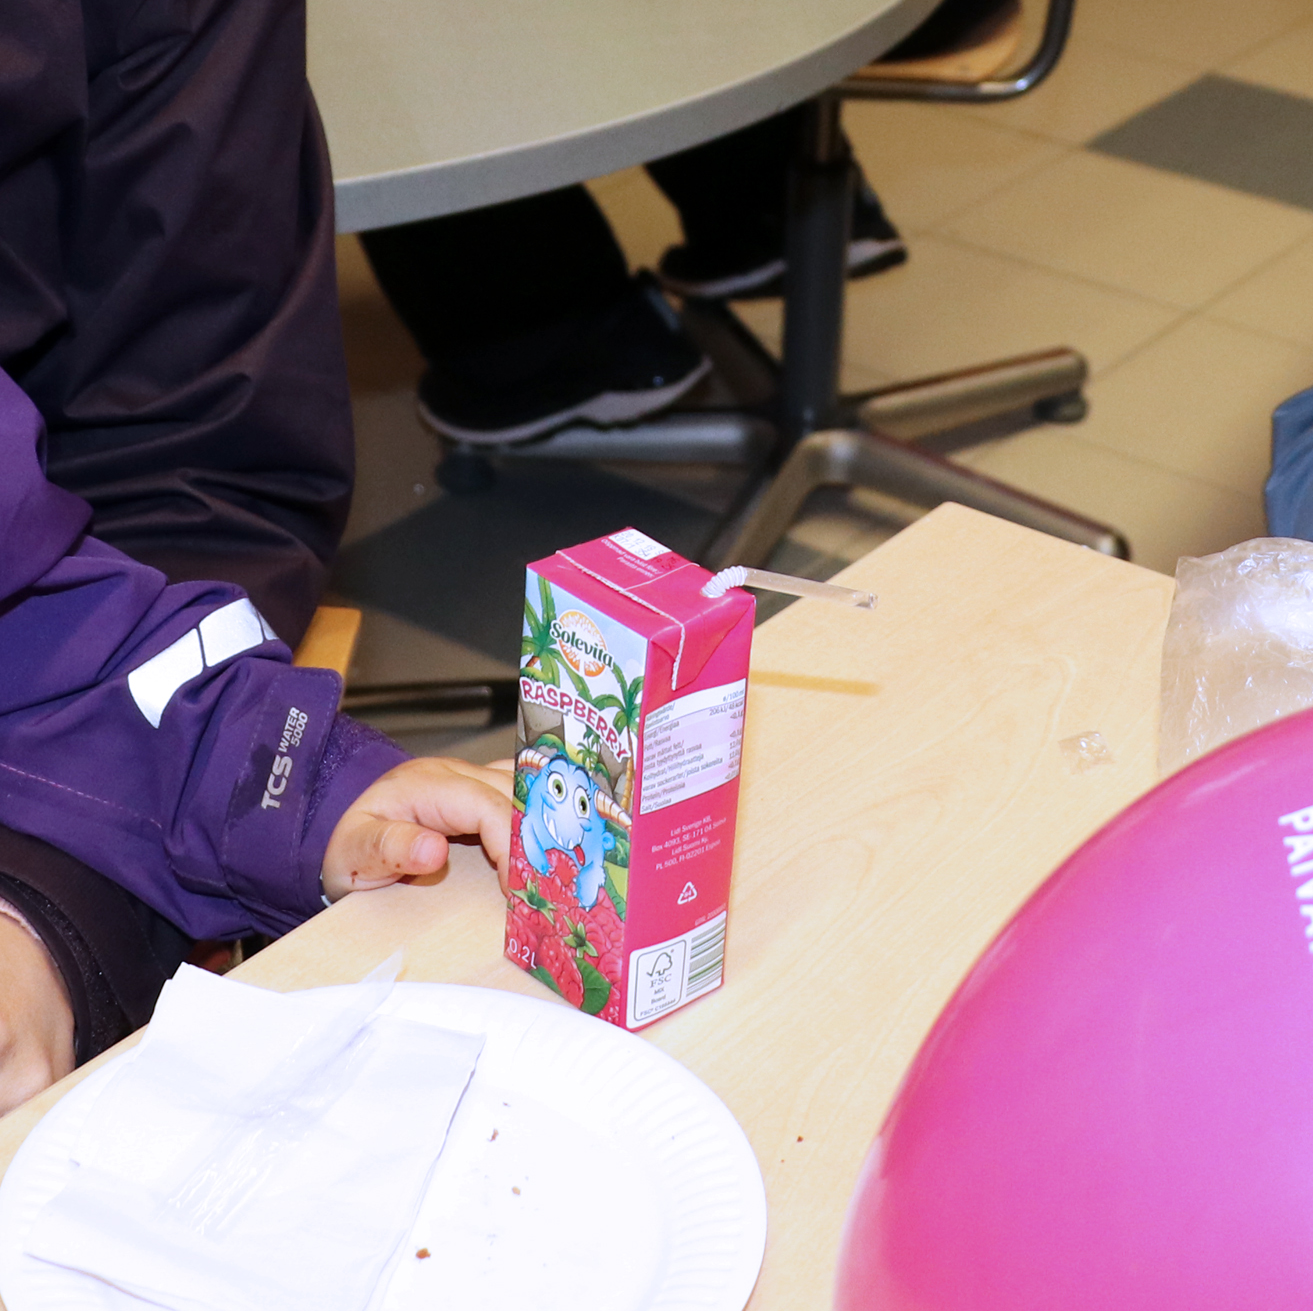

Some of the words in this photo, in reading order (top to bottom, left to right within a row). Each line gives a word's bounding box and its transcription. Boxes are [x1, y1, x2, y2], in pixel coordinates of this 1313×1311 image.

[551, 621, 614, 667] Solevita
[278, 707, 301, 753] WATER
[290, 712, 308, 747] 5000
[522, 680, 628, 758] RASPBERRY
[260, 755, 294, 810] TCS
[510, 938, 536, 969] 0,2L
[650, 973, 672, 988] FSC
